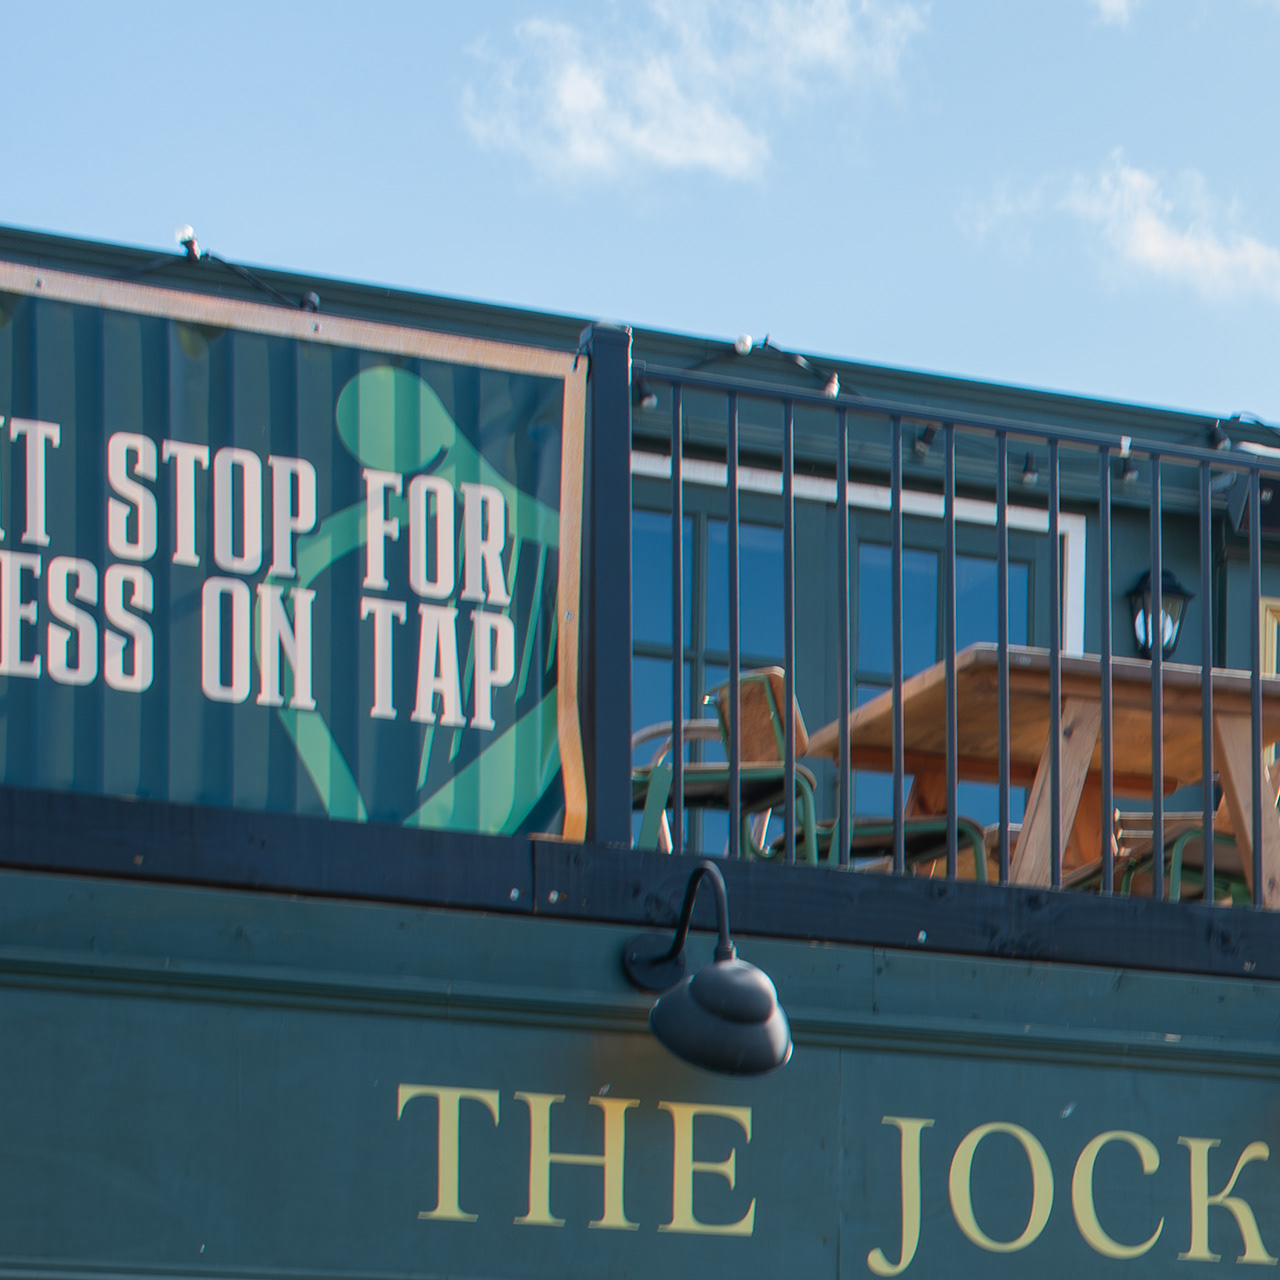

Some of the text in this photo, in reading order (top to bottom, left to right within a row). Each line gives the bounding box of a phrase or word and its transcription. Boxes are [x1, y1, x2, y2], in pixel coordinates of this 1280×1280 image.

[0, 415, 511, 606] T STOP FOR
[201, 576, 317, 711] ON
[361, 596, 515, 731] TAP
[397, 1083, 757, 1237] THE
